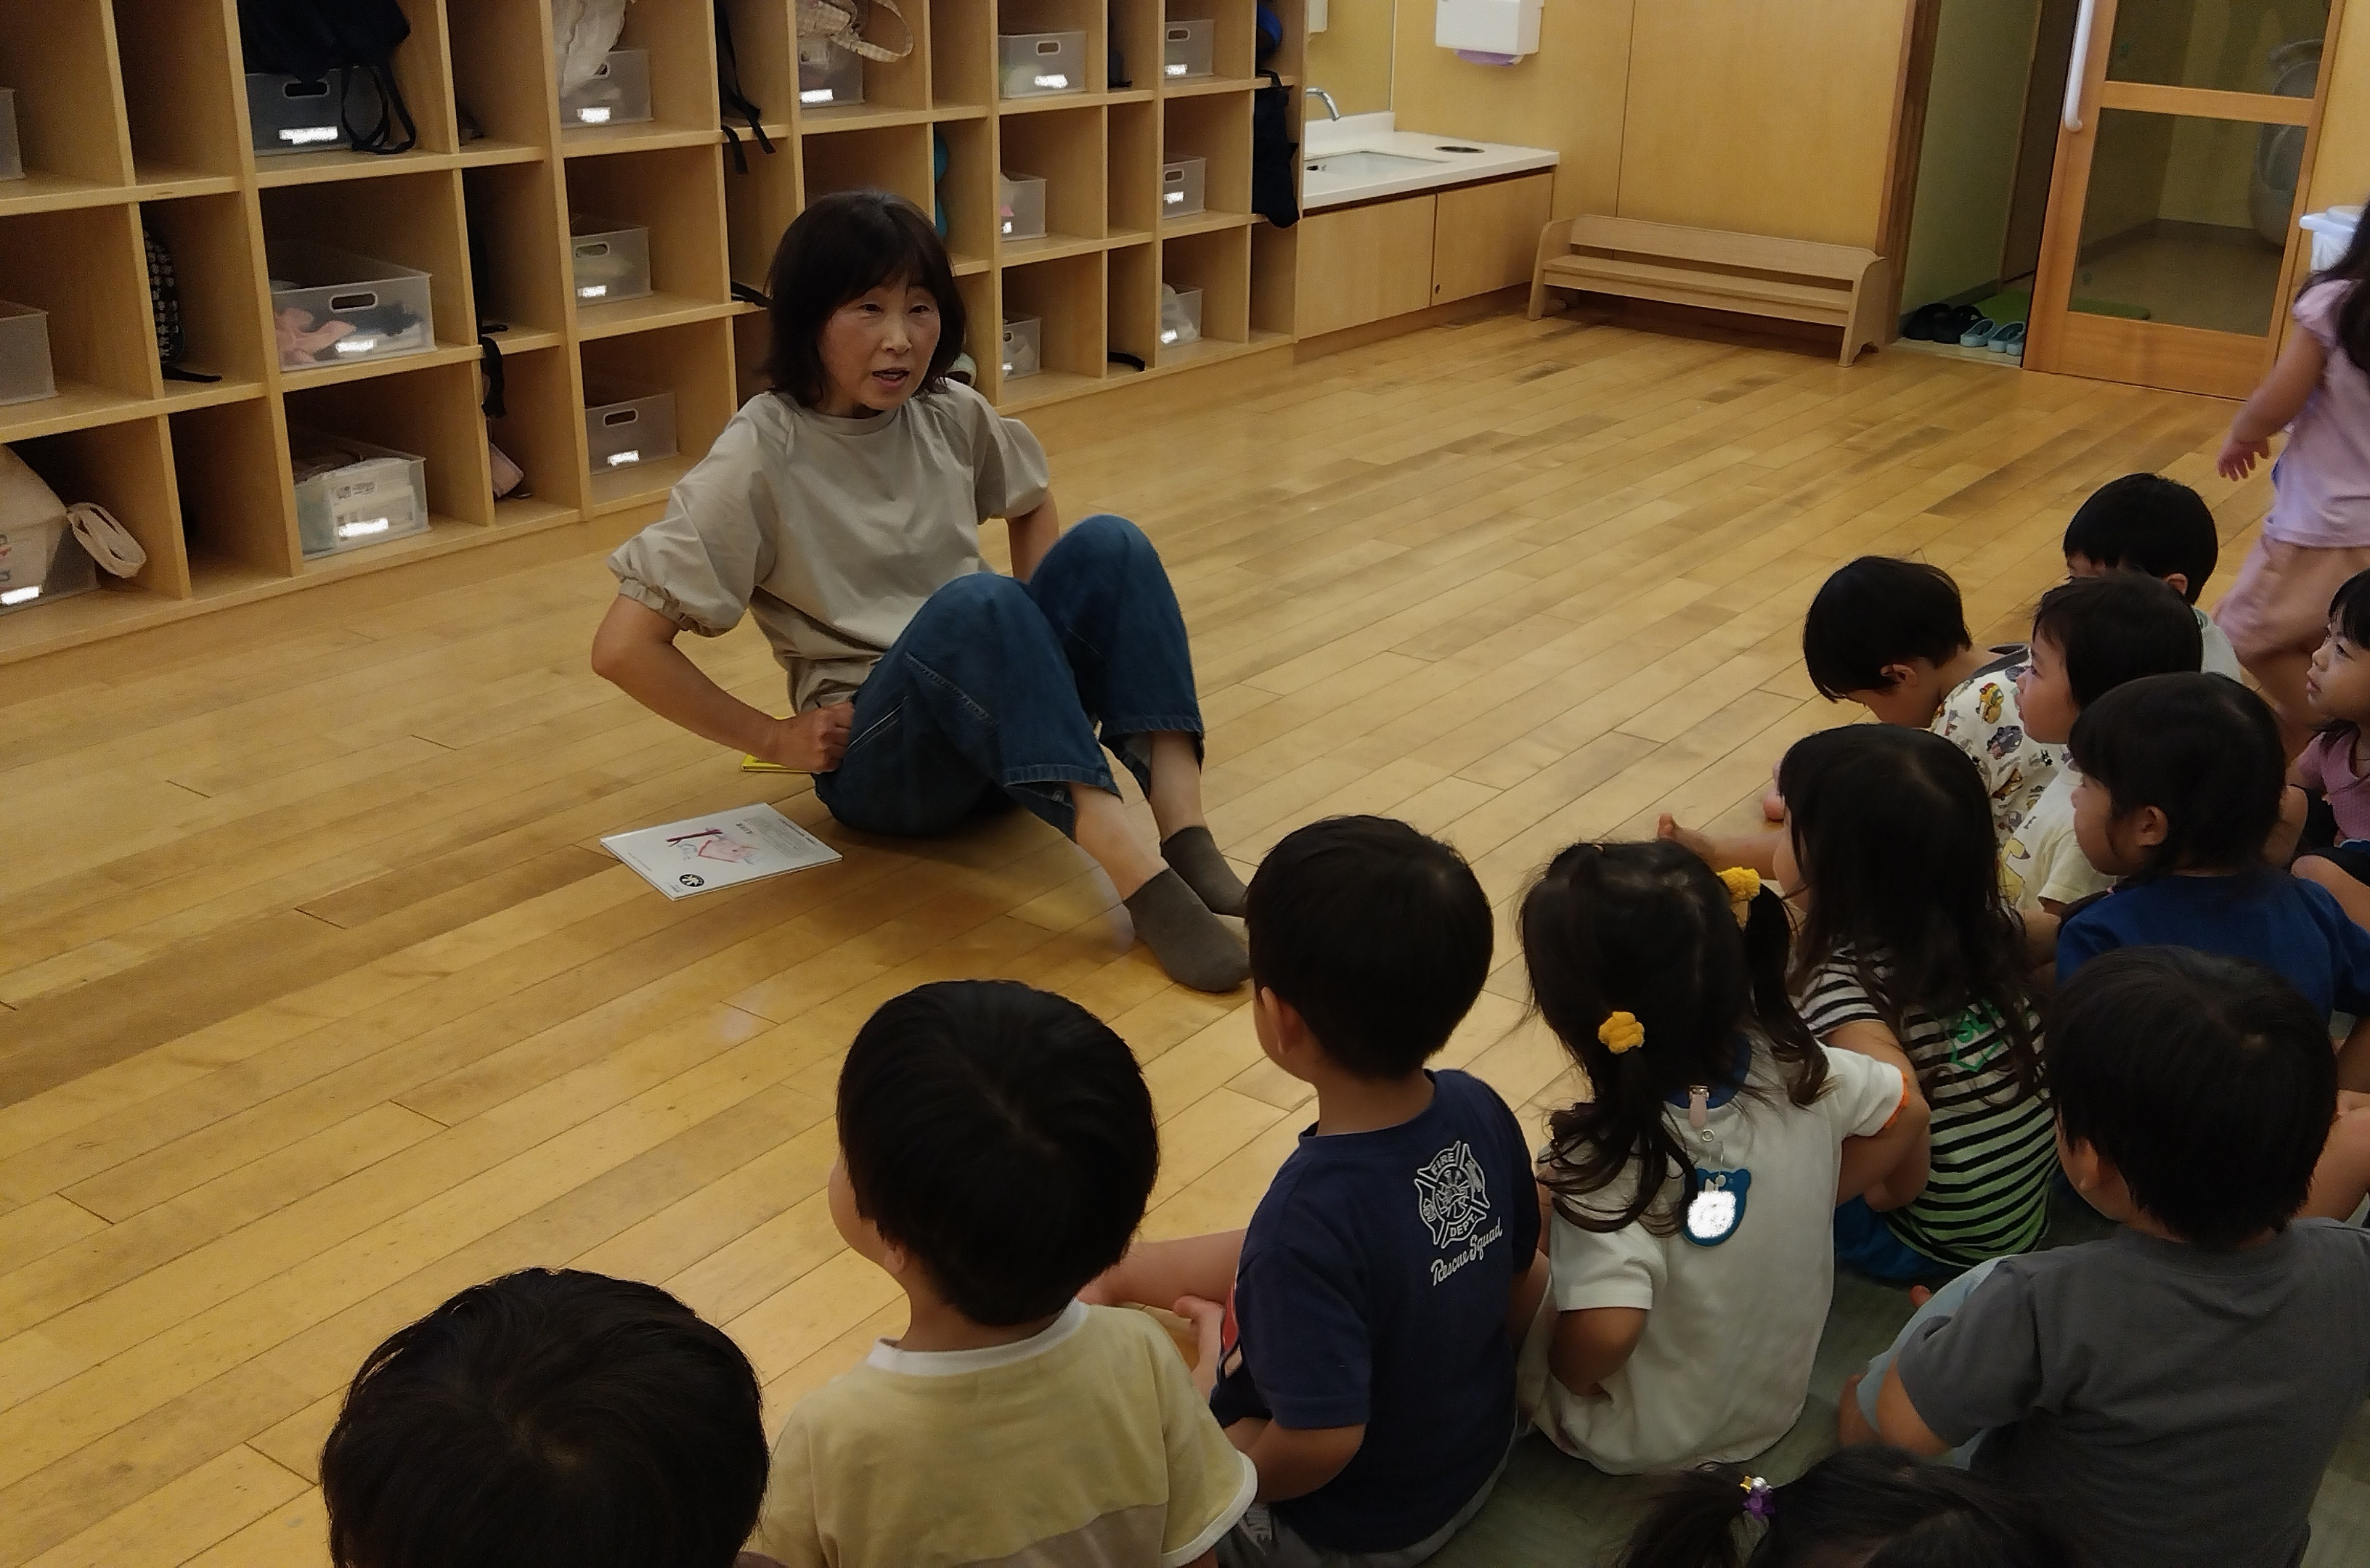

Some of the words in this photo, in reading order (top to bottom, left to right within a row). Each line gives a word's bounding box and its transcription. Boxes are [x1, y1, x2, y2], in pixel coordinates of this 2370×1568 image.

[1430, 1152, 1454, 1176] FIRE
[1430, 1249, 1470, 1286] Rescue
[1469, 1216, 1503, 1261] Squad
